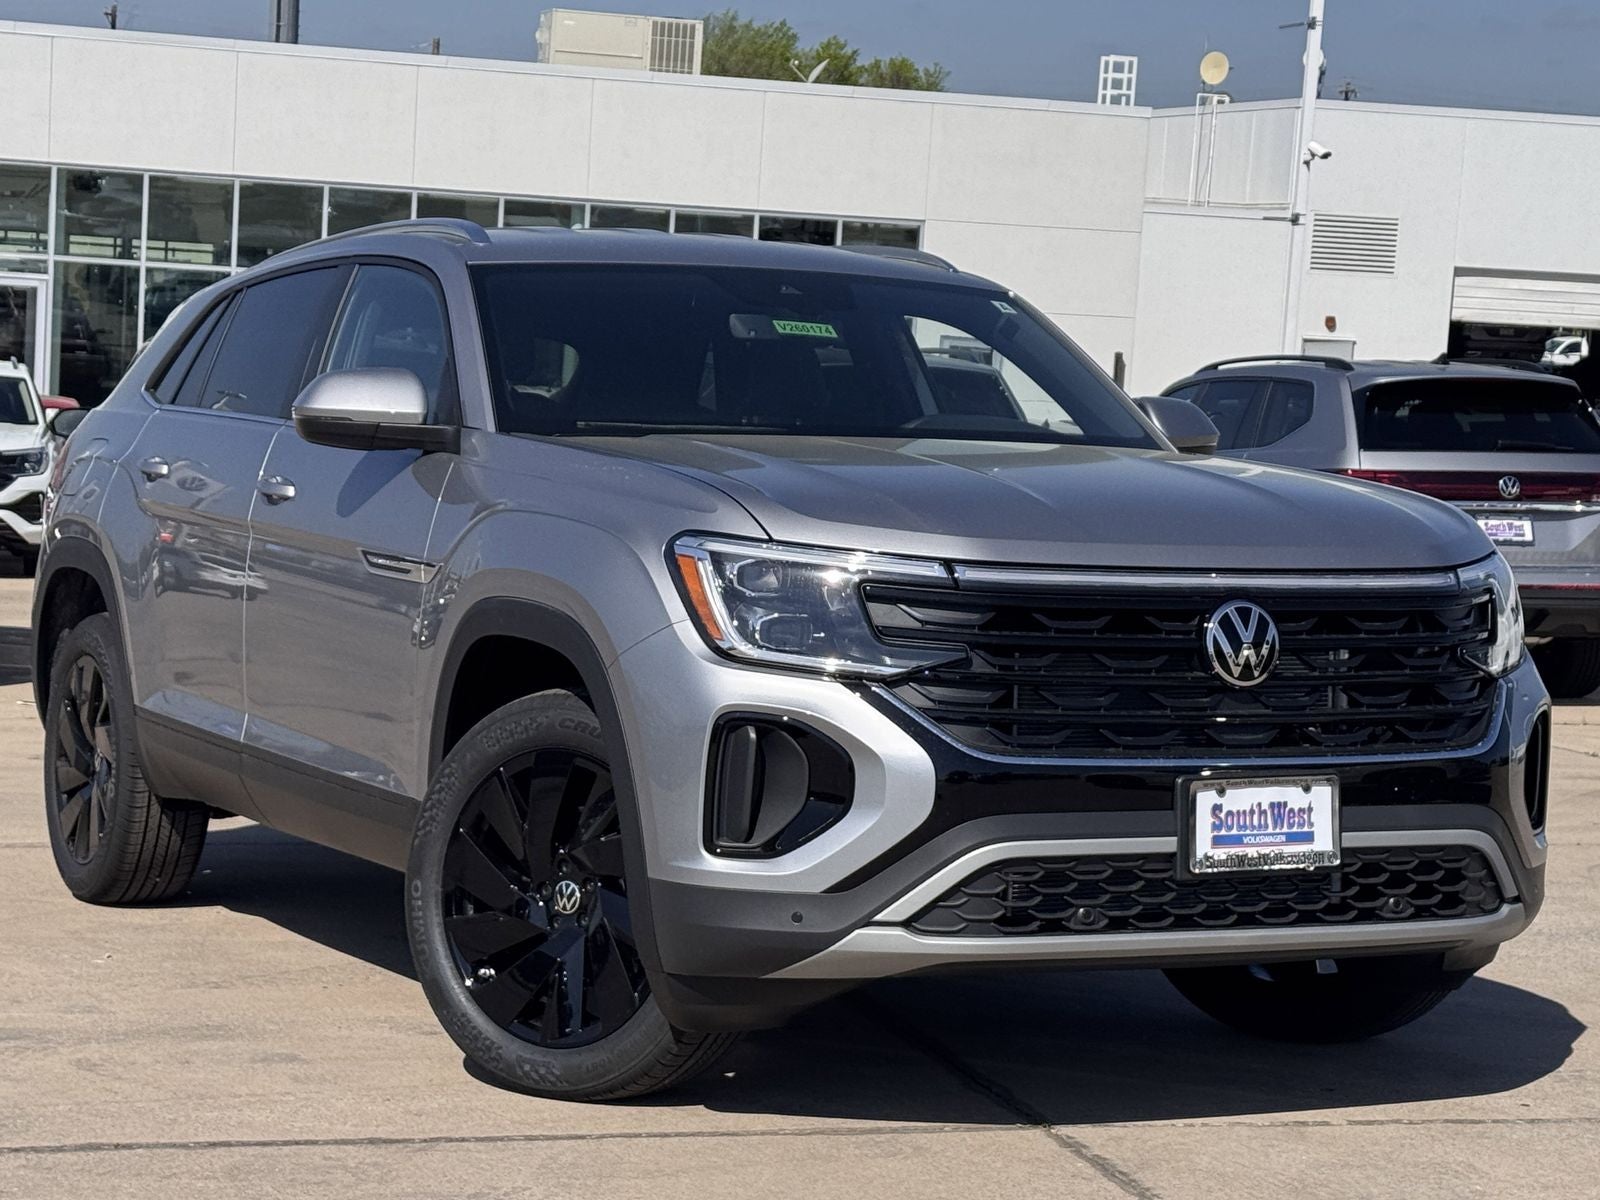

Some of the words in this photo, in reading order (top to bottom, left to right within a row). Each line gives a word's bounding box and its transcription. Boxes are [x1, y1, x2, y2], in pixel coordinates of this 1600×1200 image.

[776, 321, 833, 335] V260174
[1499, 476, 1520, 498] VW
[1207, 602, 1279, 687] VW
[1243, 835, 1286, 844] VOLKSWAGEN
[554, 880, 581, 914] VW
